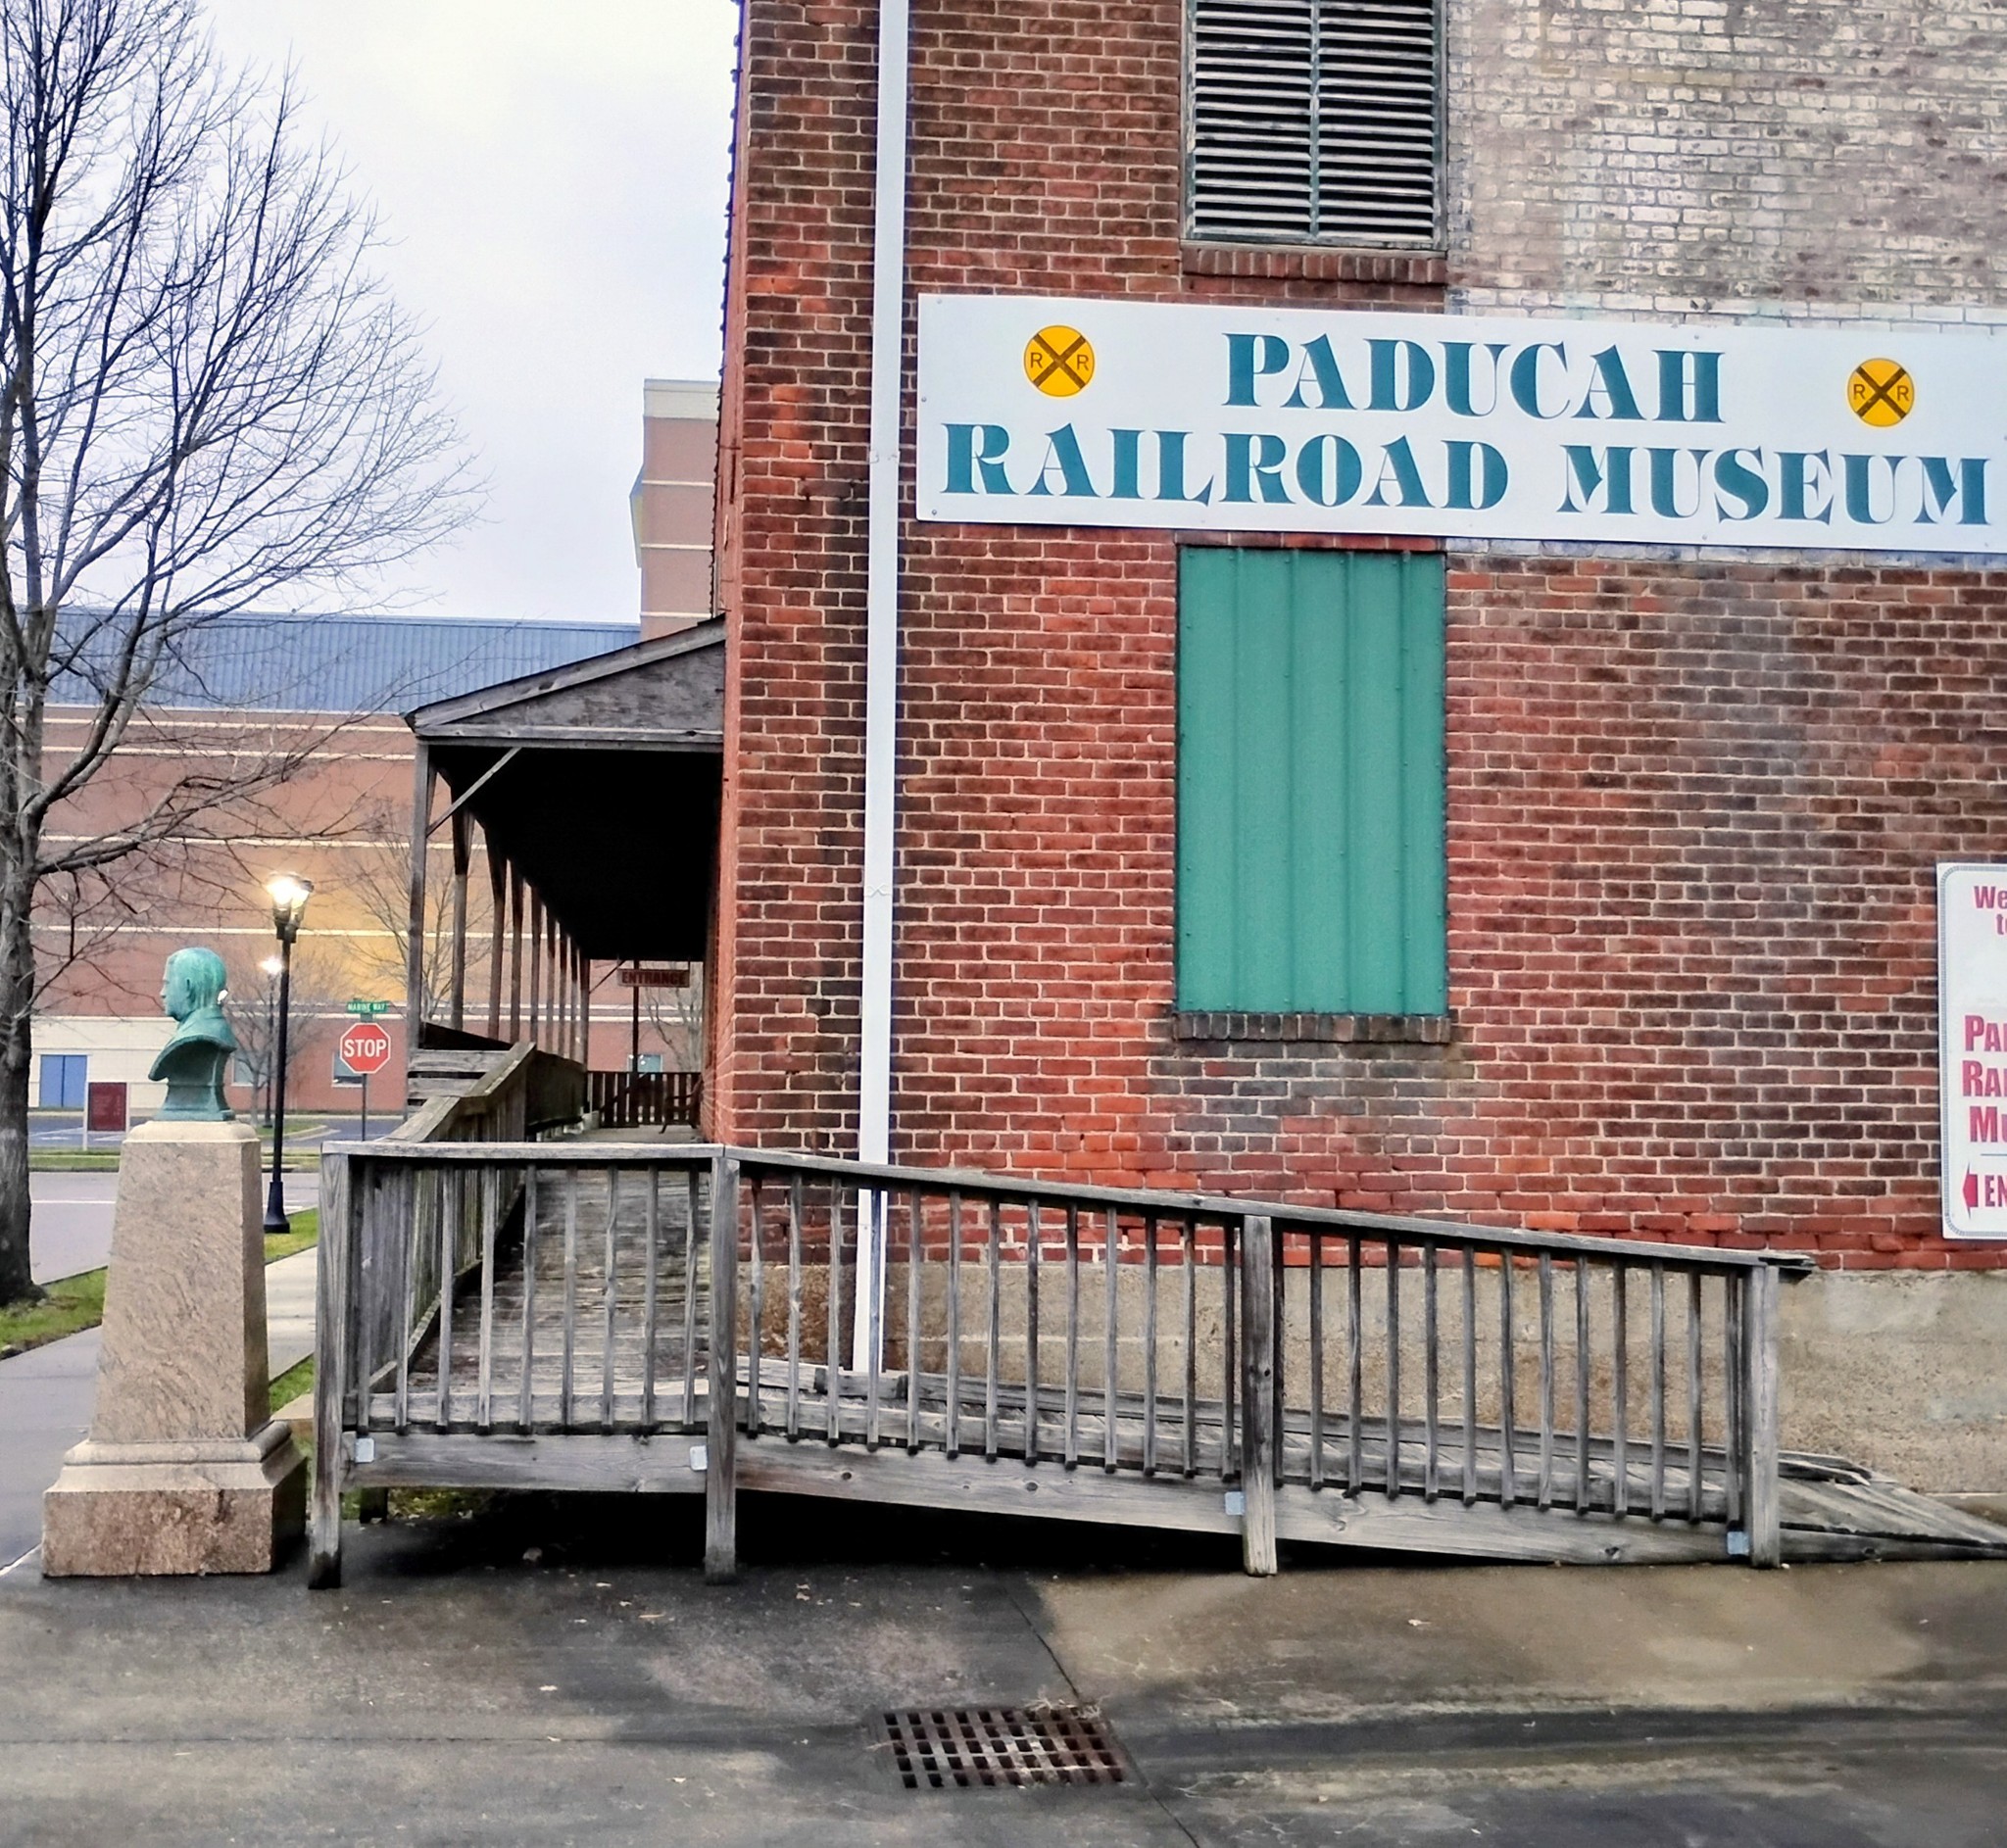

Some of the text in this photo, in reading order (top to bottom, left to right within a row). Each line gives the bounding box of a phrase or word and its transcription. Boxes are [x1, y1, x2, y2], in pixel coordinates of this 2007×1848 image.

[1222, 332, 1726, 423] PADUCAH
[941, 422, 1991, 526] RAILROAD MUSEUM
[622, 971, 686, 985] ENTRANCE
[343, 1039, 387, 1057] STOP
